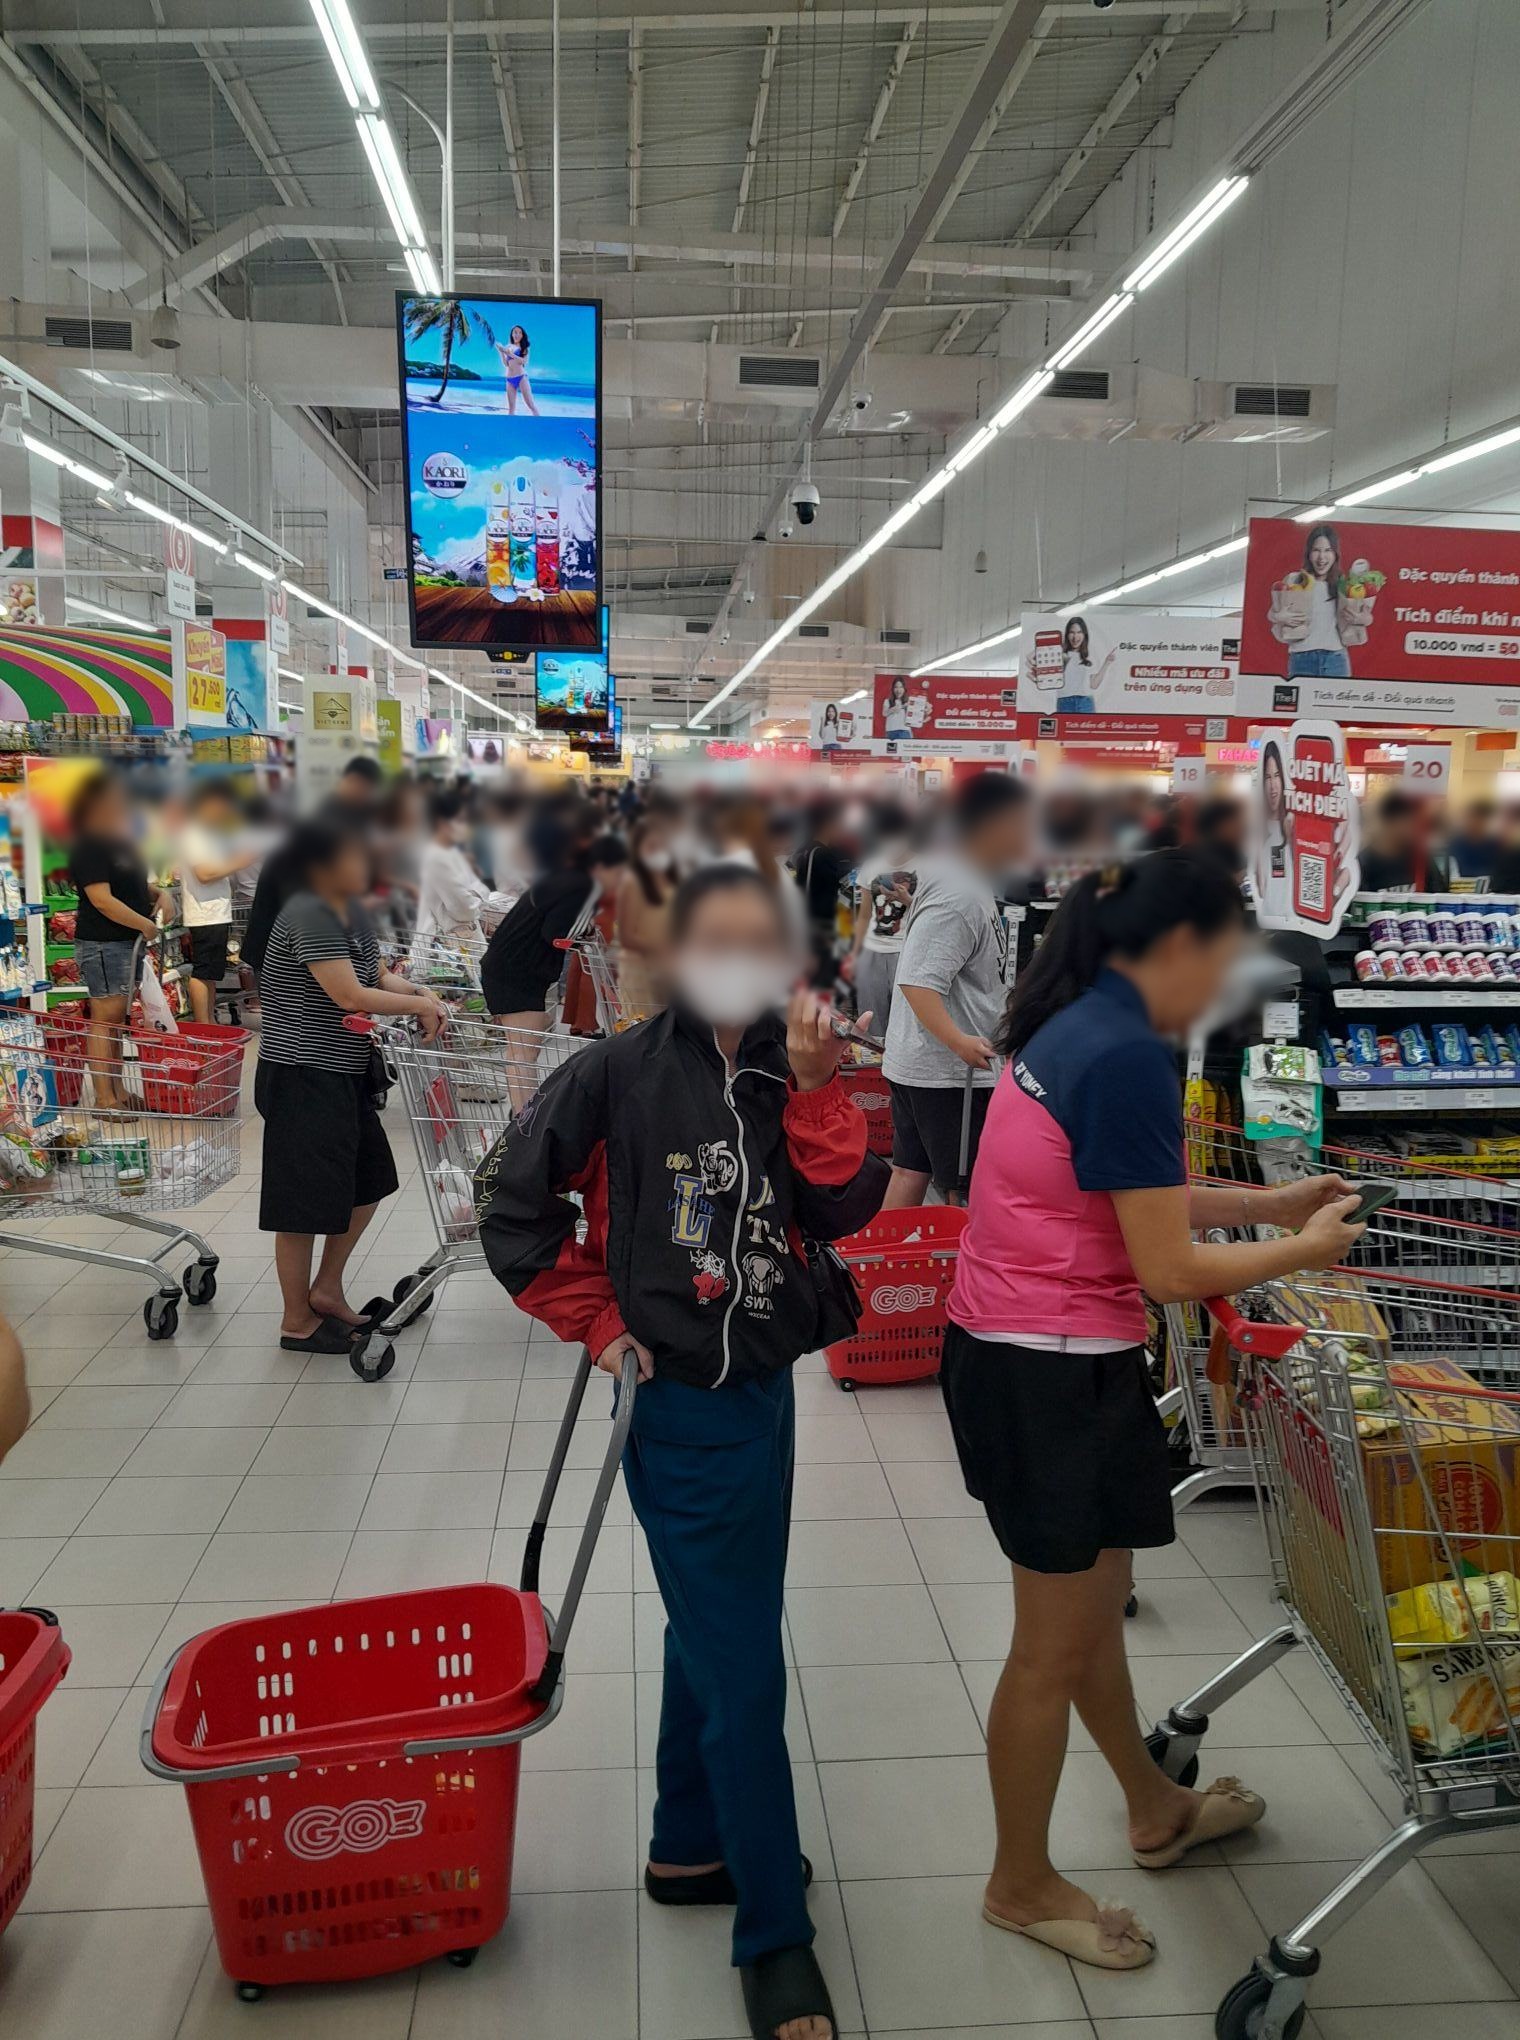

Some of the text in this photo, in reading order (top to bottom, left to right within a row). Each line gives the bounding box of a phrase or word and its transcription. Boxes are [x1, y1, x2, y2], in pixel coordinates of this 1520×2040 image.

[425, 467, 465, 478] KAORI
[1398, 567, 1428, 583] Đặc
[1394, 607, 1431, 622] Tích
[1434, 605, 1478, 625] điểm
[1481, 611, 1509, 626] khi
[1119, 642, 1137, 652] Đặc
[1200, 644, 1219, 652] viên
[1413, 639, 1458, 651] 10.000
[1124, 682, 1147, 692] trên
[1150, 682, 1171, 694] ứng
[1175, 683, 1203, 694] dụng
[1218, 748, 1259, 761] FAHAS
[1181, 768, 1198, 781] 18
[1287, 754, 1321, 782] QUÉT
[1411, 761, 1442, 779] 20
[672, 1173, 712, 1248] L
